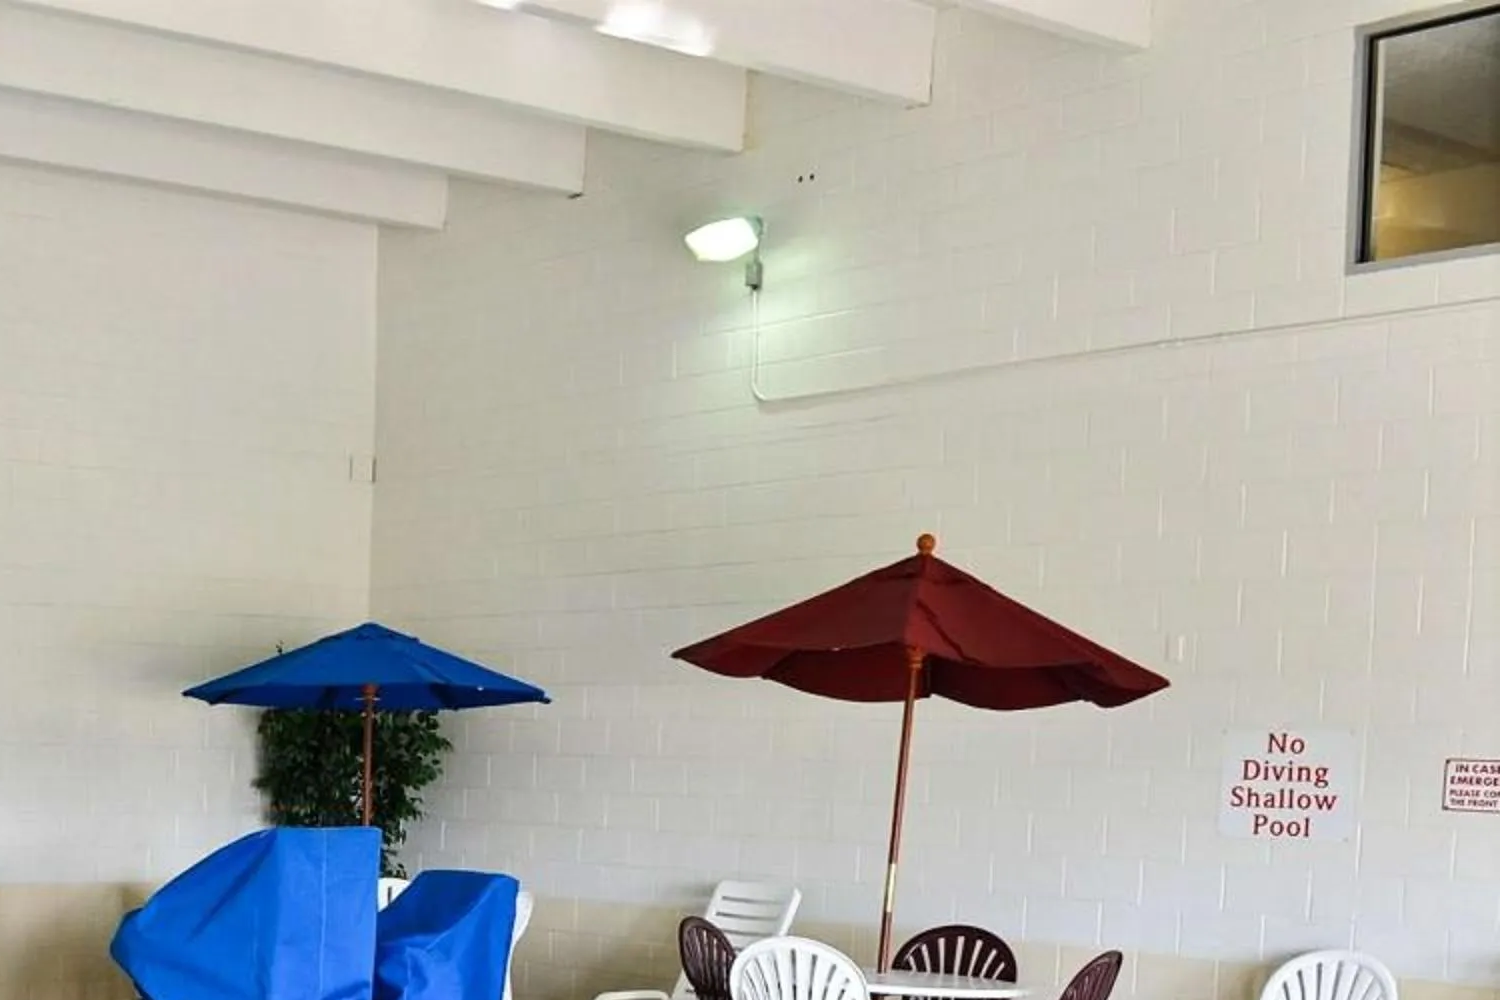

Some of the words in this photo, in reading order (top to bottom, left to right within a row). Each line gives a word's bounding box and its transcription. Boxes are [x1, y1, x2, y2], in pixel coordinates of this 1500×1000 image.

[1267, 732, 1306, 755] No
[1242, 759, 1330, 789] Diving
[1455, 764, 1469, 773] IN
[1230, 785, 1337, 811] Shallow
[1449, 789, 1481, 797] PLEASE
[1468, 799, 1498, 808] FRONT
[1252, 814, 1311, 838] Pool
